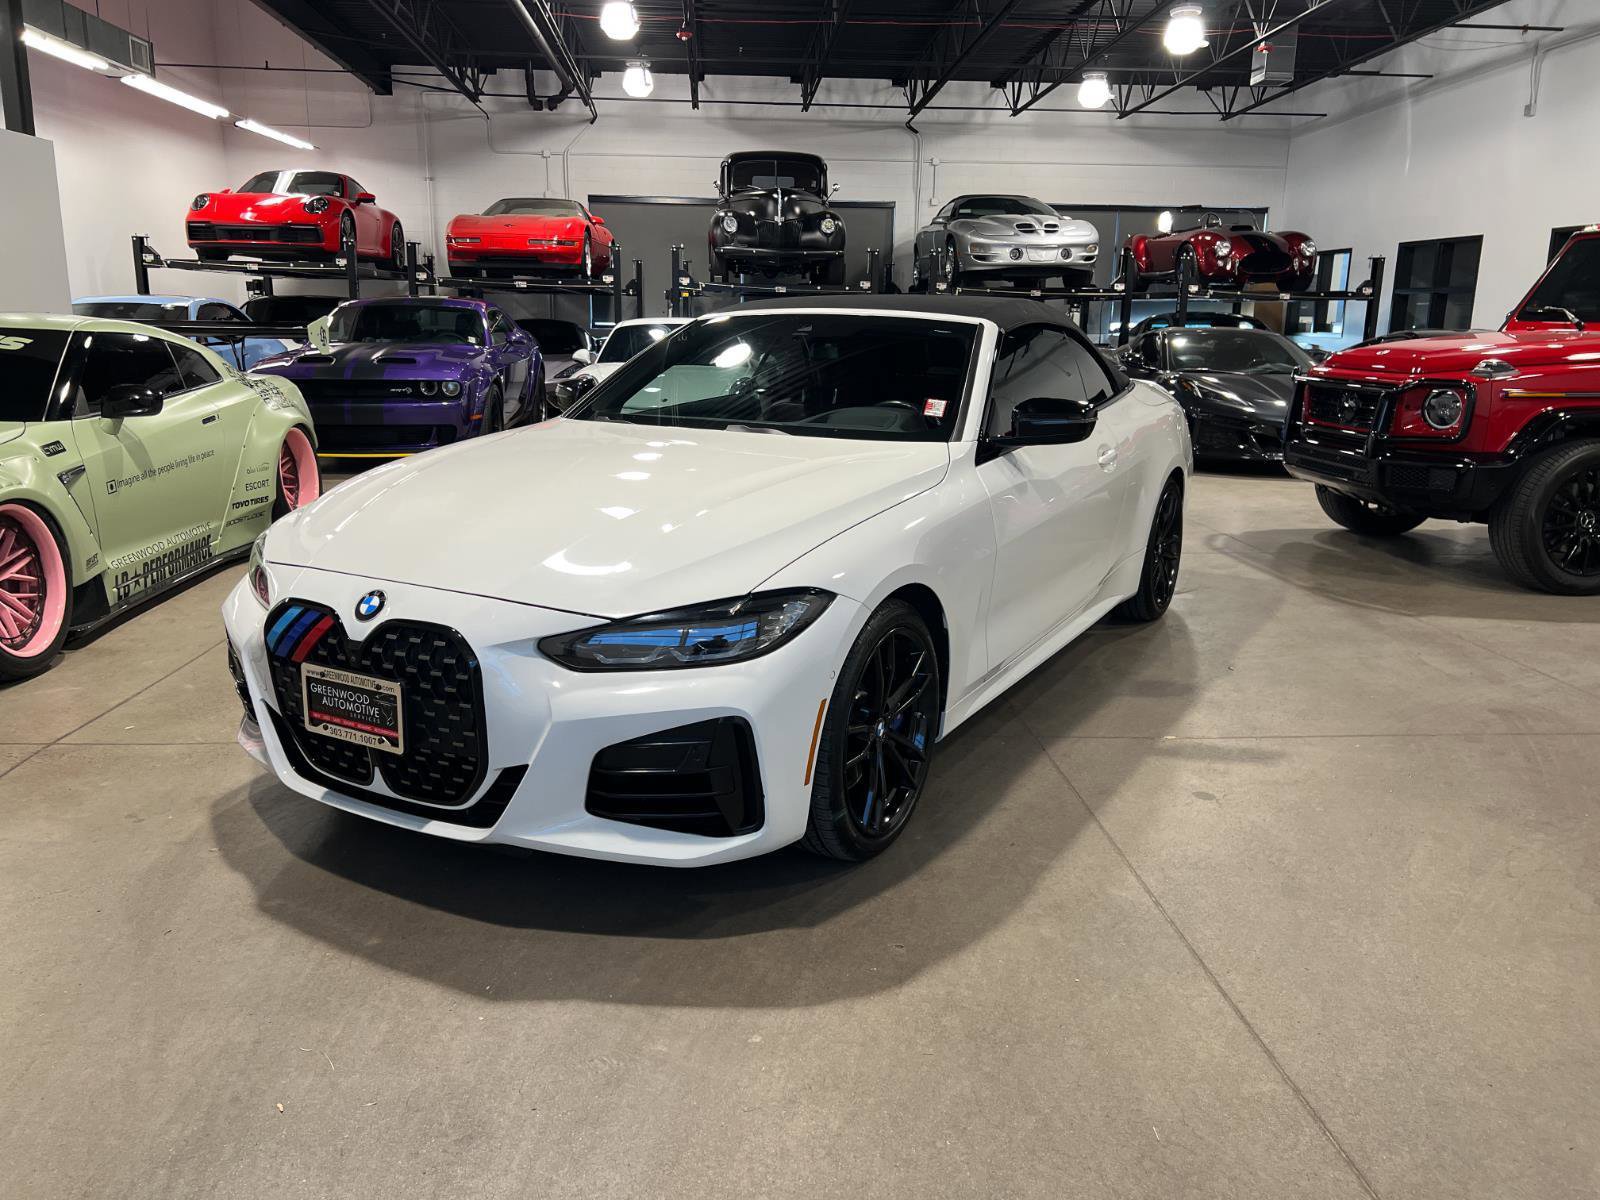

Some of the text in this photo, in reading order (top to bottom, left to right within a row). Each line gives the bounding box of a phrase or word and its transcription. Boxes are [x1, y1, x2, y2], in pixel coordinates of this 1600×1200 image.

[148, 469, 157, 478] the
[157, 463, 175, 475] people
[175, 458, 189, 468] living
[201, 449, 215, 460] peace
[245, 479, 270, 491] ESCORT
[232, 495, 269, 510] TOYO TIRES
[110, 541, 165, 571] GREENWOOD
[166, 521, 212, 548] AUTOMOTIVE
[310, 683, 370, 704] GREENWOOD
[322, 695, 380, 718] AUTOMOTIVE
